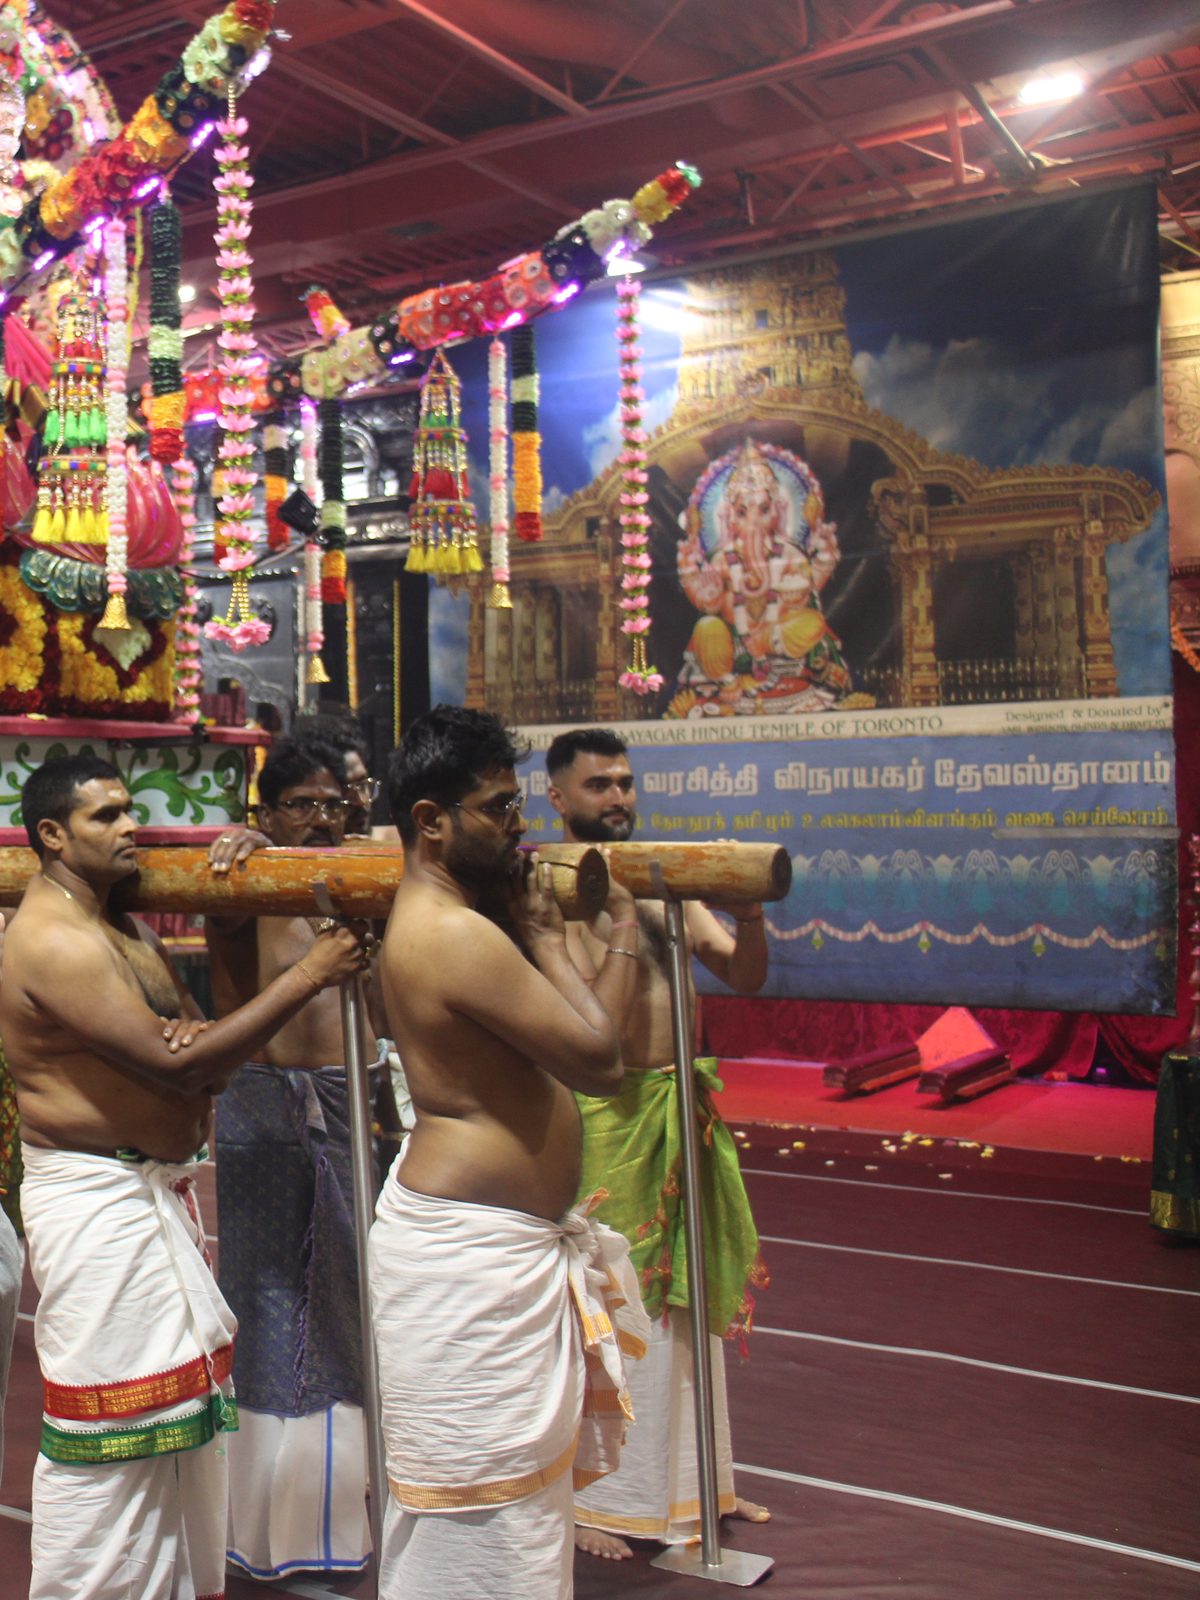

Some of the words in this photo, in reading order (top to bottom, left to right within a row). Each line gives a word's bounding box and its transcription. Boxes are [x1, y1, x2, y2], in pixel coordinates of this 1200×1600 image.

[1005, 709, 1064, 723] Designed
[1072, 708, 1085, 718] &
[1088, 705, 1143, 718] Donated
[1147, 703, 1162, 717] by
[691, 725, 744, 740] HINDU
[751, 721, 818, 739] TEMPLE
[822, 719, 844, 736] OF
[851, 715, 943, 735] TORONTO
[643, 762, 759, 797] வரசித்தி
[774, 757, 926, 796] விநாயகர்
[934, 752, 1171, 793] தேவஸ்தானம்
